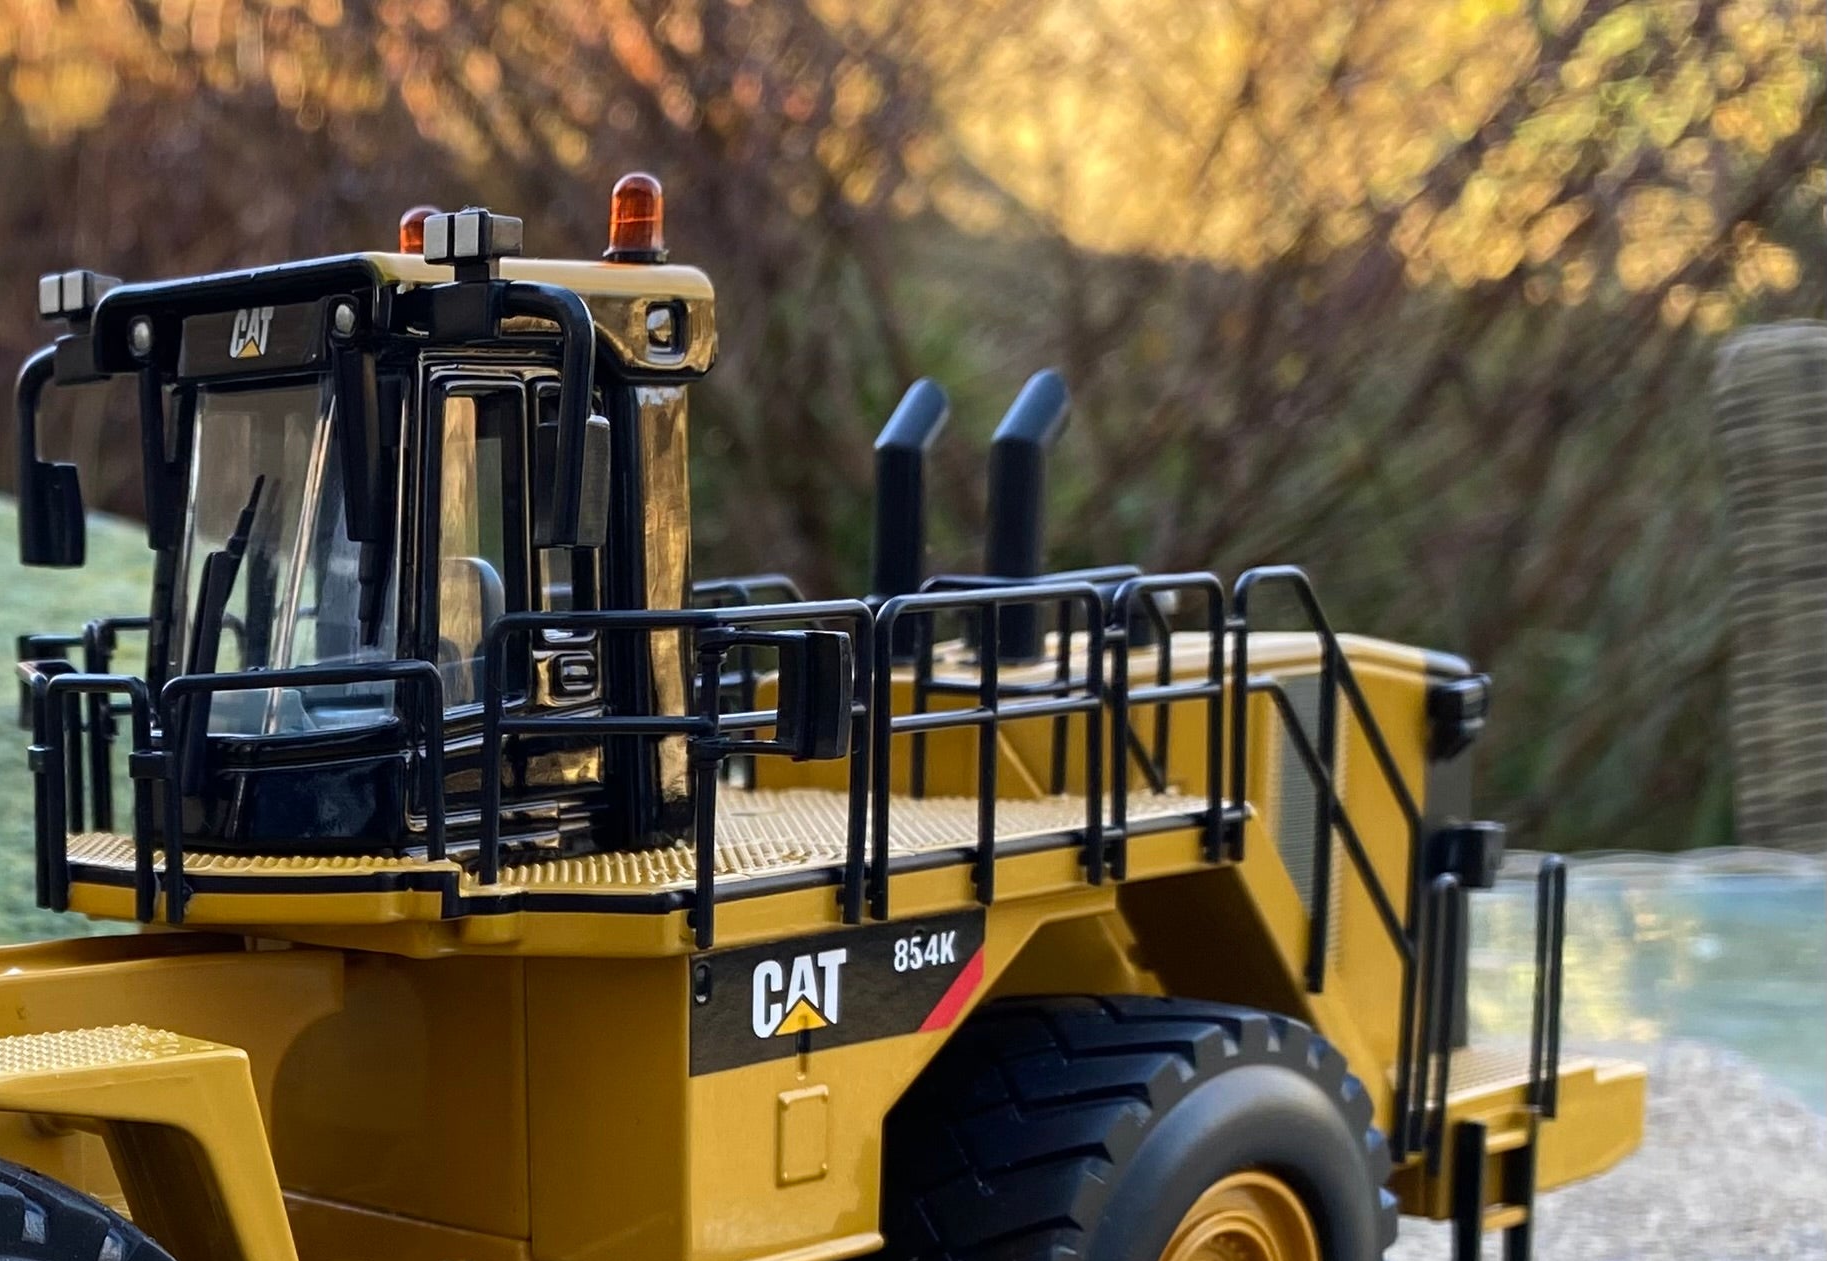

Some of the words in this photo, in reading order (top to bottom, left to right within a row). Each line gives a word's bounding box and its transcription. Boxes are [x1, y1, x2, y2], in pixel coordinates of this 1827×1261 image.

[229, 306, 274, 358] CAT
[752, 948, 847, 1038] CAT
[893, 930, 956, 973] 854K
